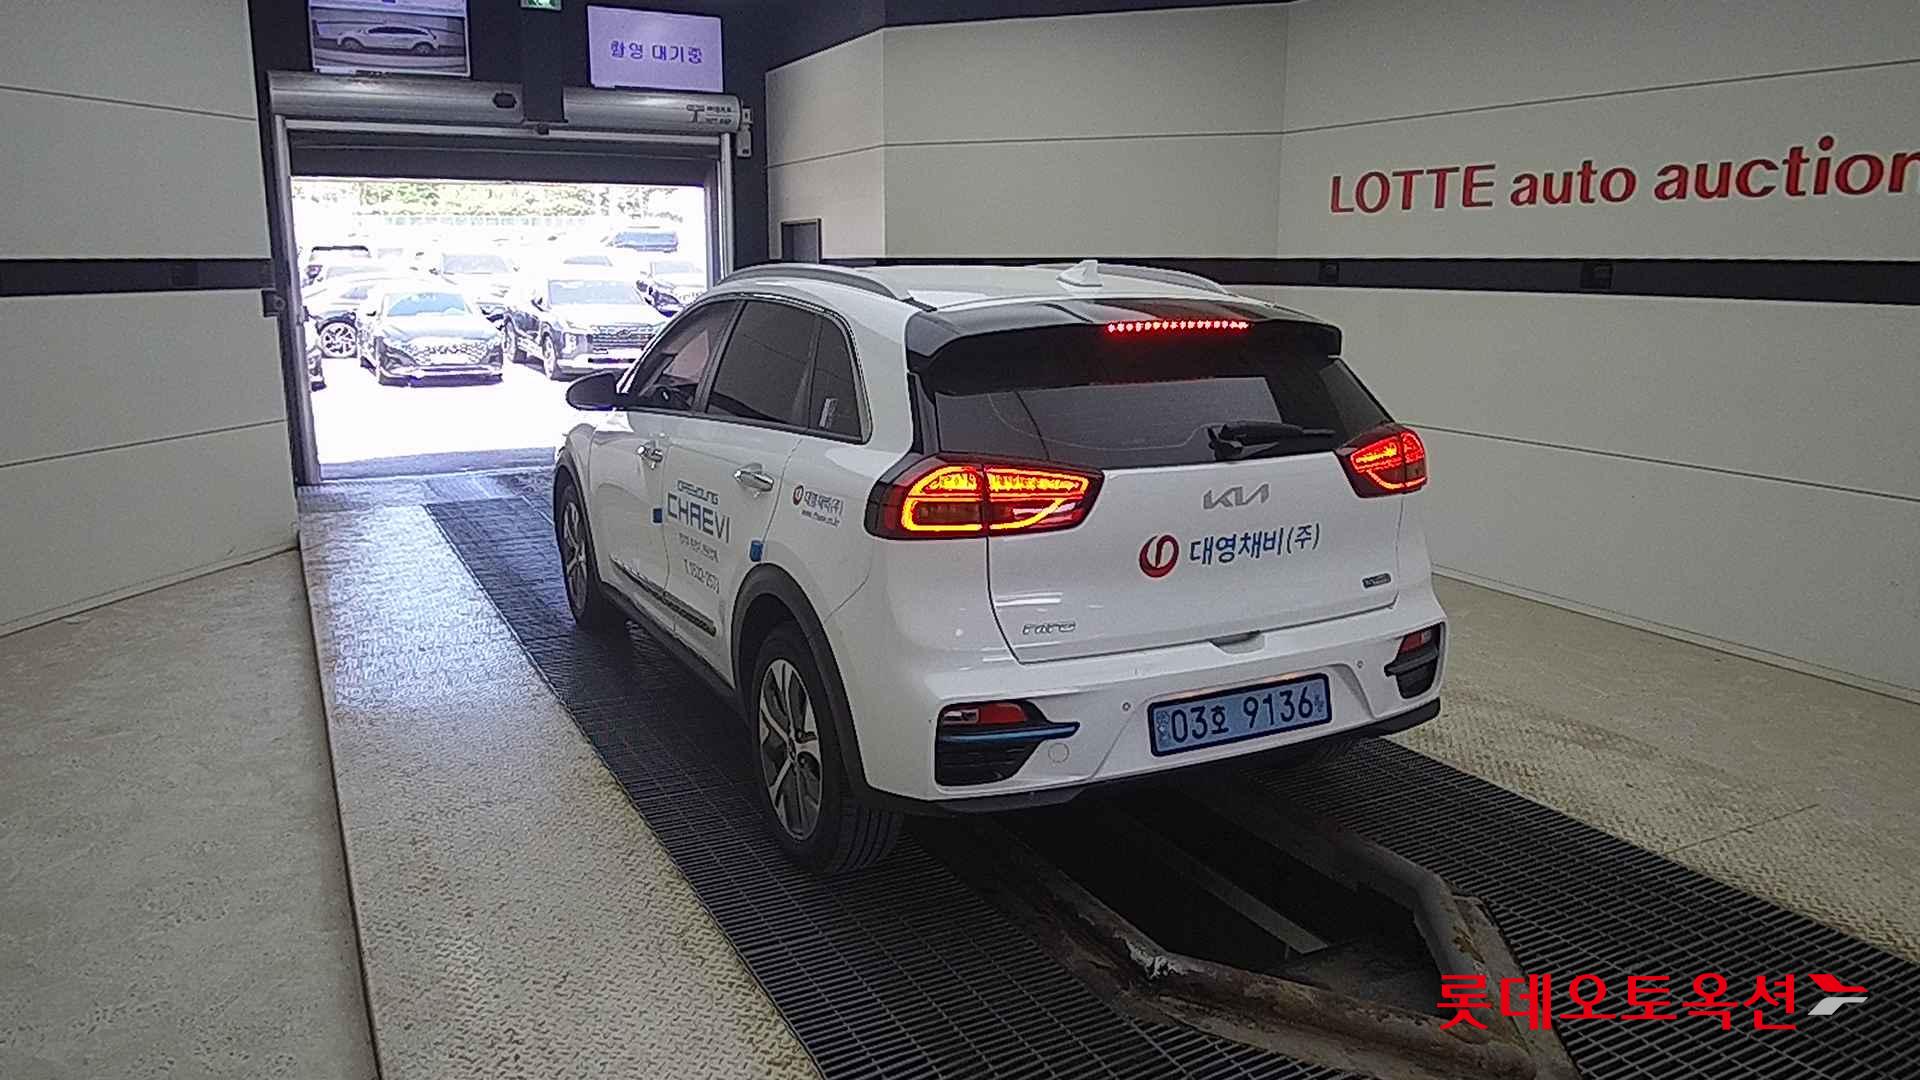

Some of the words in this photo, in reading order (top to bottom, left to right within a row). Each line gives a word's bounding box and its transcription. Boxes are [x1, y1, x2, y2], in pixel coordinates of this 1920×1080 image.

[1330, 164, 1496, 214] LOTTE
[1510, 159, 1637, 208] auto
[667, 492, 731, 544] CHAEVI
[1189, 522, 1321, 566] 대영채비(주)
[1170, 704, 1229, 744] 03호
[1243, 685, 1314, 729] 9136
